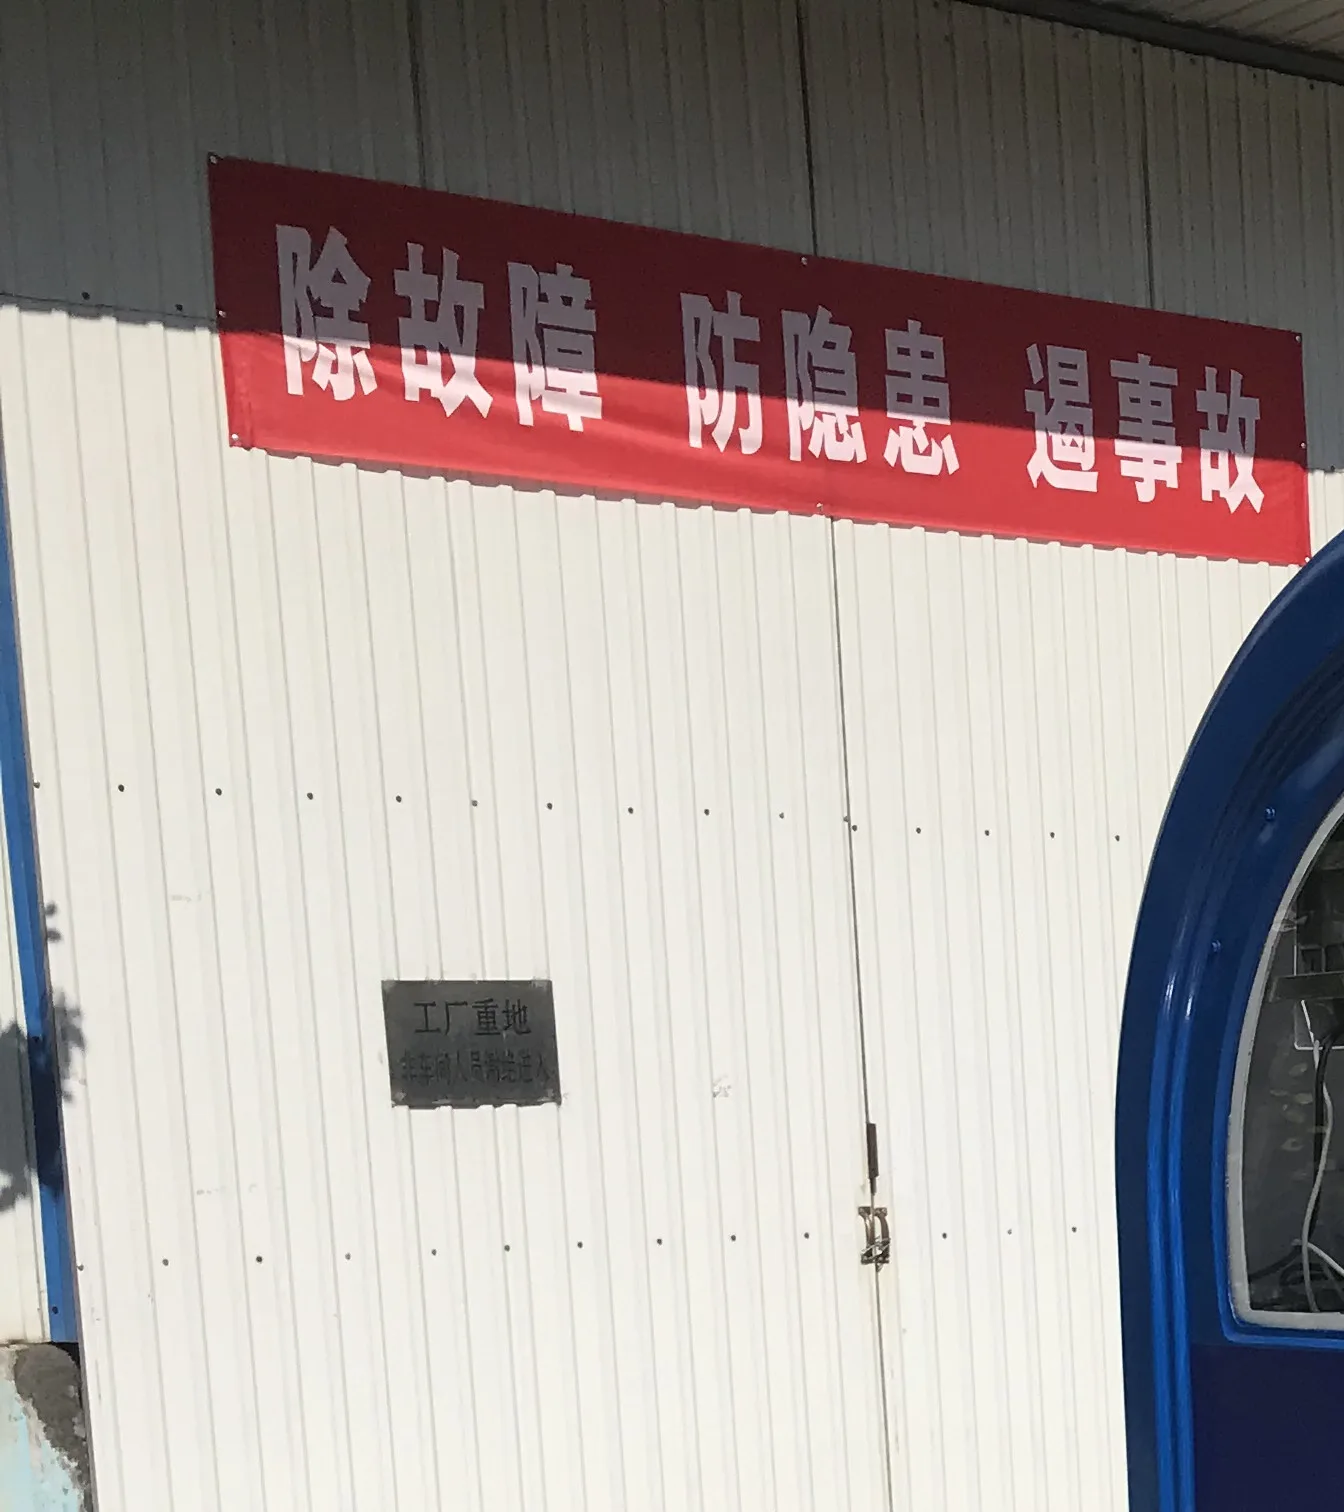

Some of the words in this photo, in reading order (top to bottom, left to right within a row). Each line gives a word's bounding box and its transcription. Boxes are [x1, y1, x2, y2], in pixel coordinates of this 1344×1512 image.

[276, 224, 603, 432] 除故障
[681, 290, 958, 476] 防隐患
[1025, 342, 1265, 514] 遏事故
[413, 998, 532, 1036] 工厂重地
